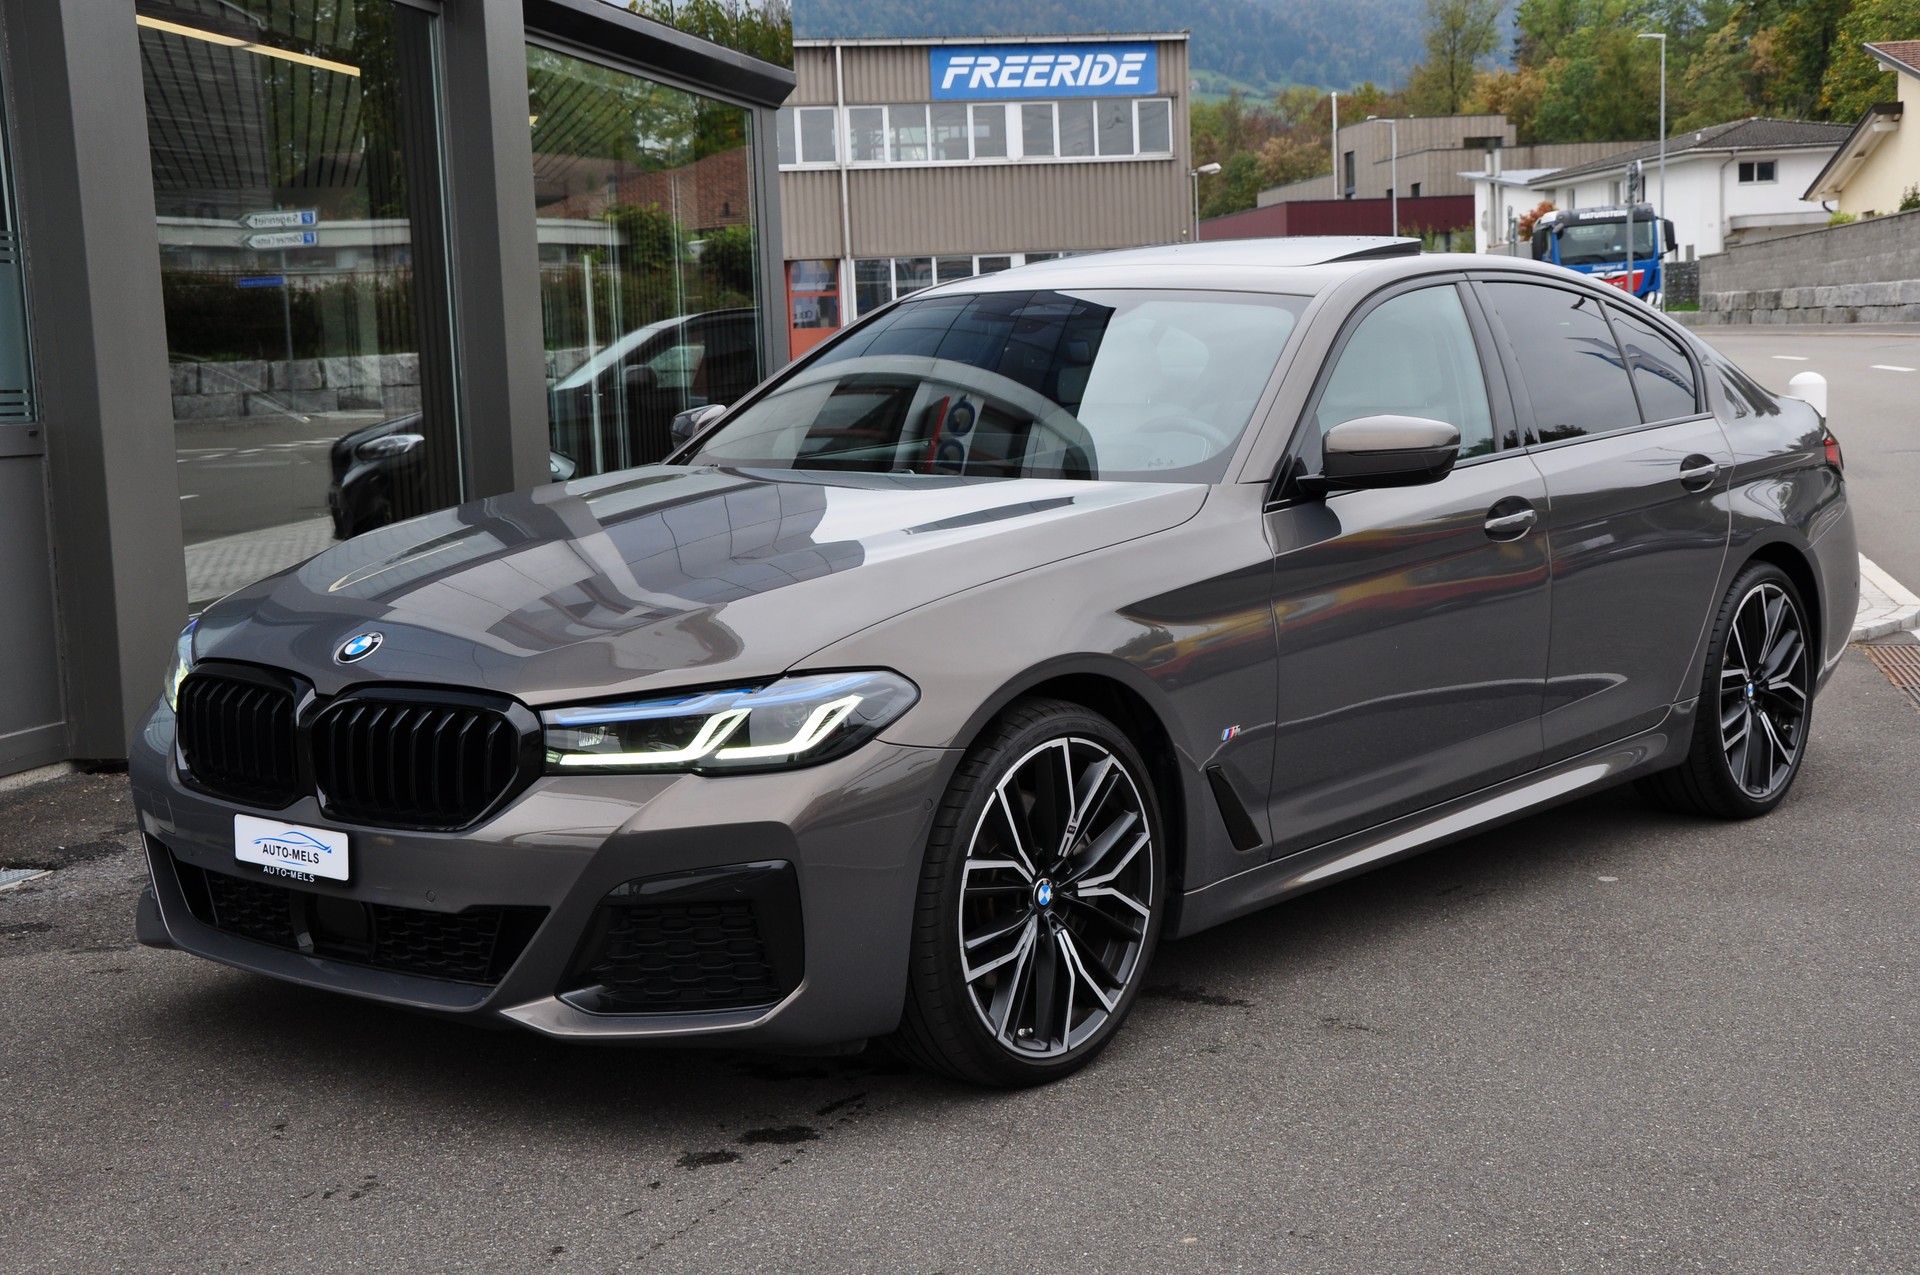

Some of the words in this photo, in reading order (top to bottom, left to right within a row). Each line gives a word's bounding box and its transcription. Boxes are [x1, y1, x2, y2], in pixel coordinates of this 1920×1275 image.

[941, 52, 1147, 89] FREERIDE
[262, 843, 320, 865] AUTO-MELS
[263, 865, 315, 883] AUTO-MELS
